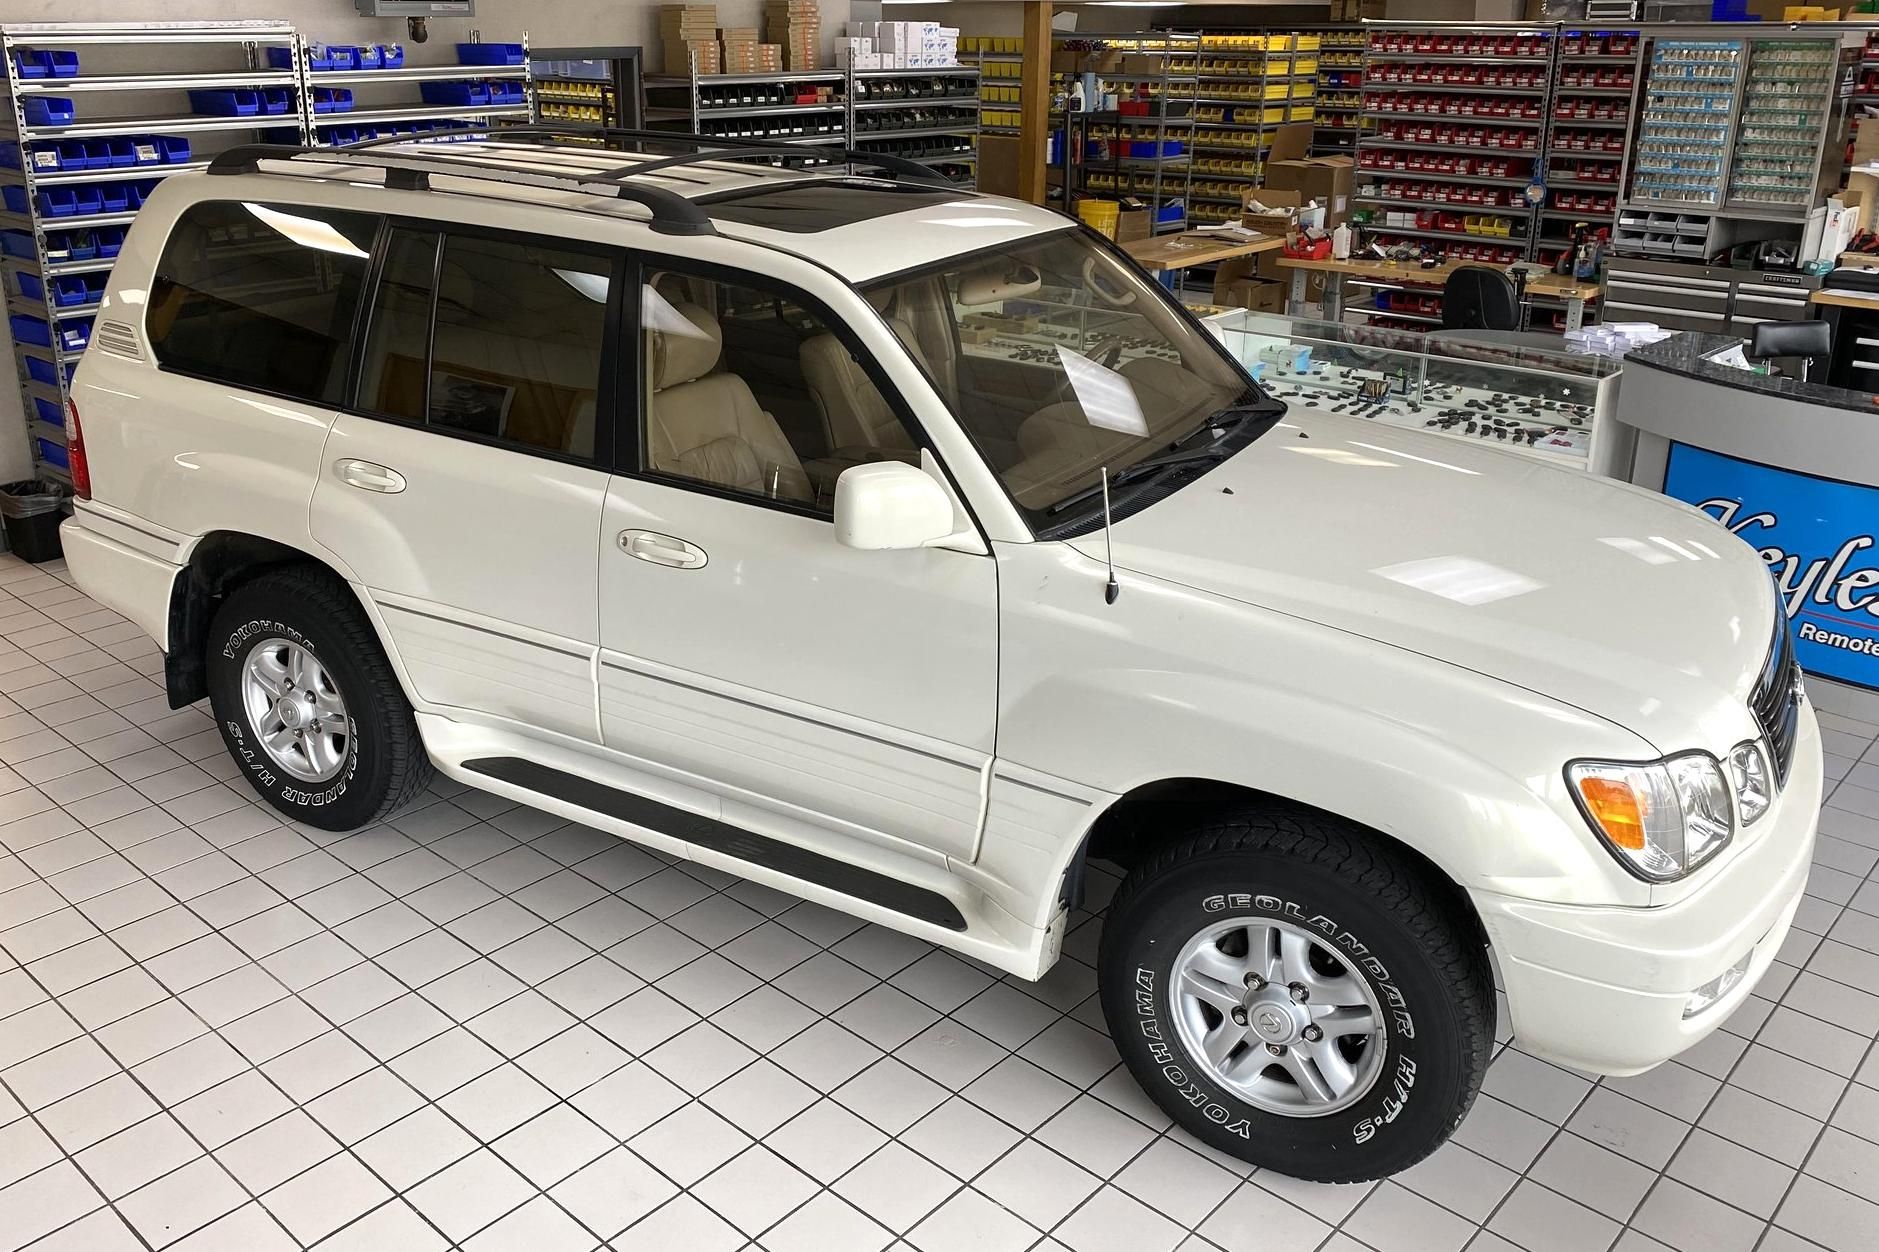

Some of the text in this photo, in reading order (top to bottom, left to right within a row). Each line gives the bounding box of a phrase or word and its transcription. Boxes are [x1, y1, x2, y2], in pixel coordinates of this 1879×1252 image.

[1695, 497, 1879, 620] Keyle
[222, 619, 316, 660] YOKOHAMA
[1202, 893, 1415, 1040] GEOLANDAR
[1135, 968, 1252, 1140] YOKOHAMA
